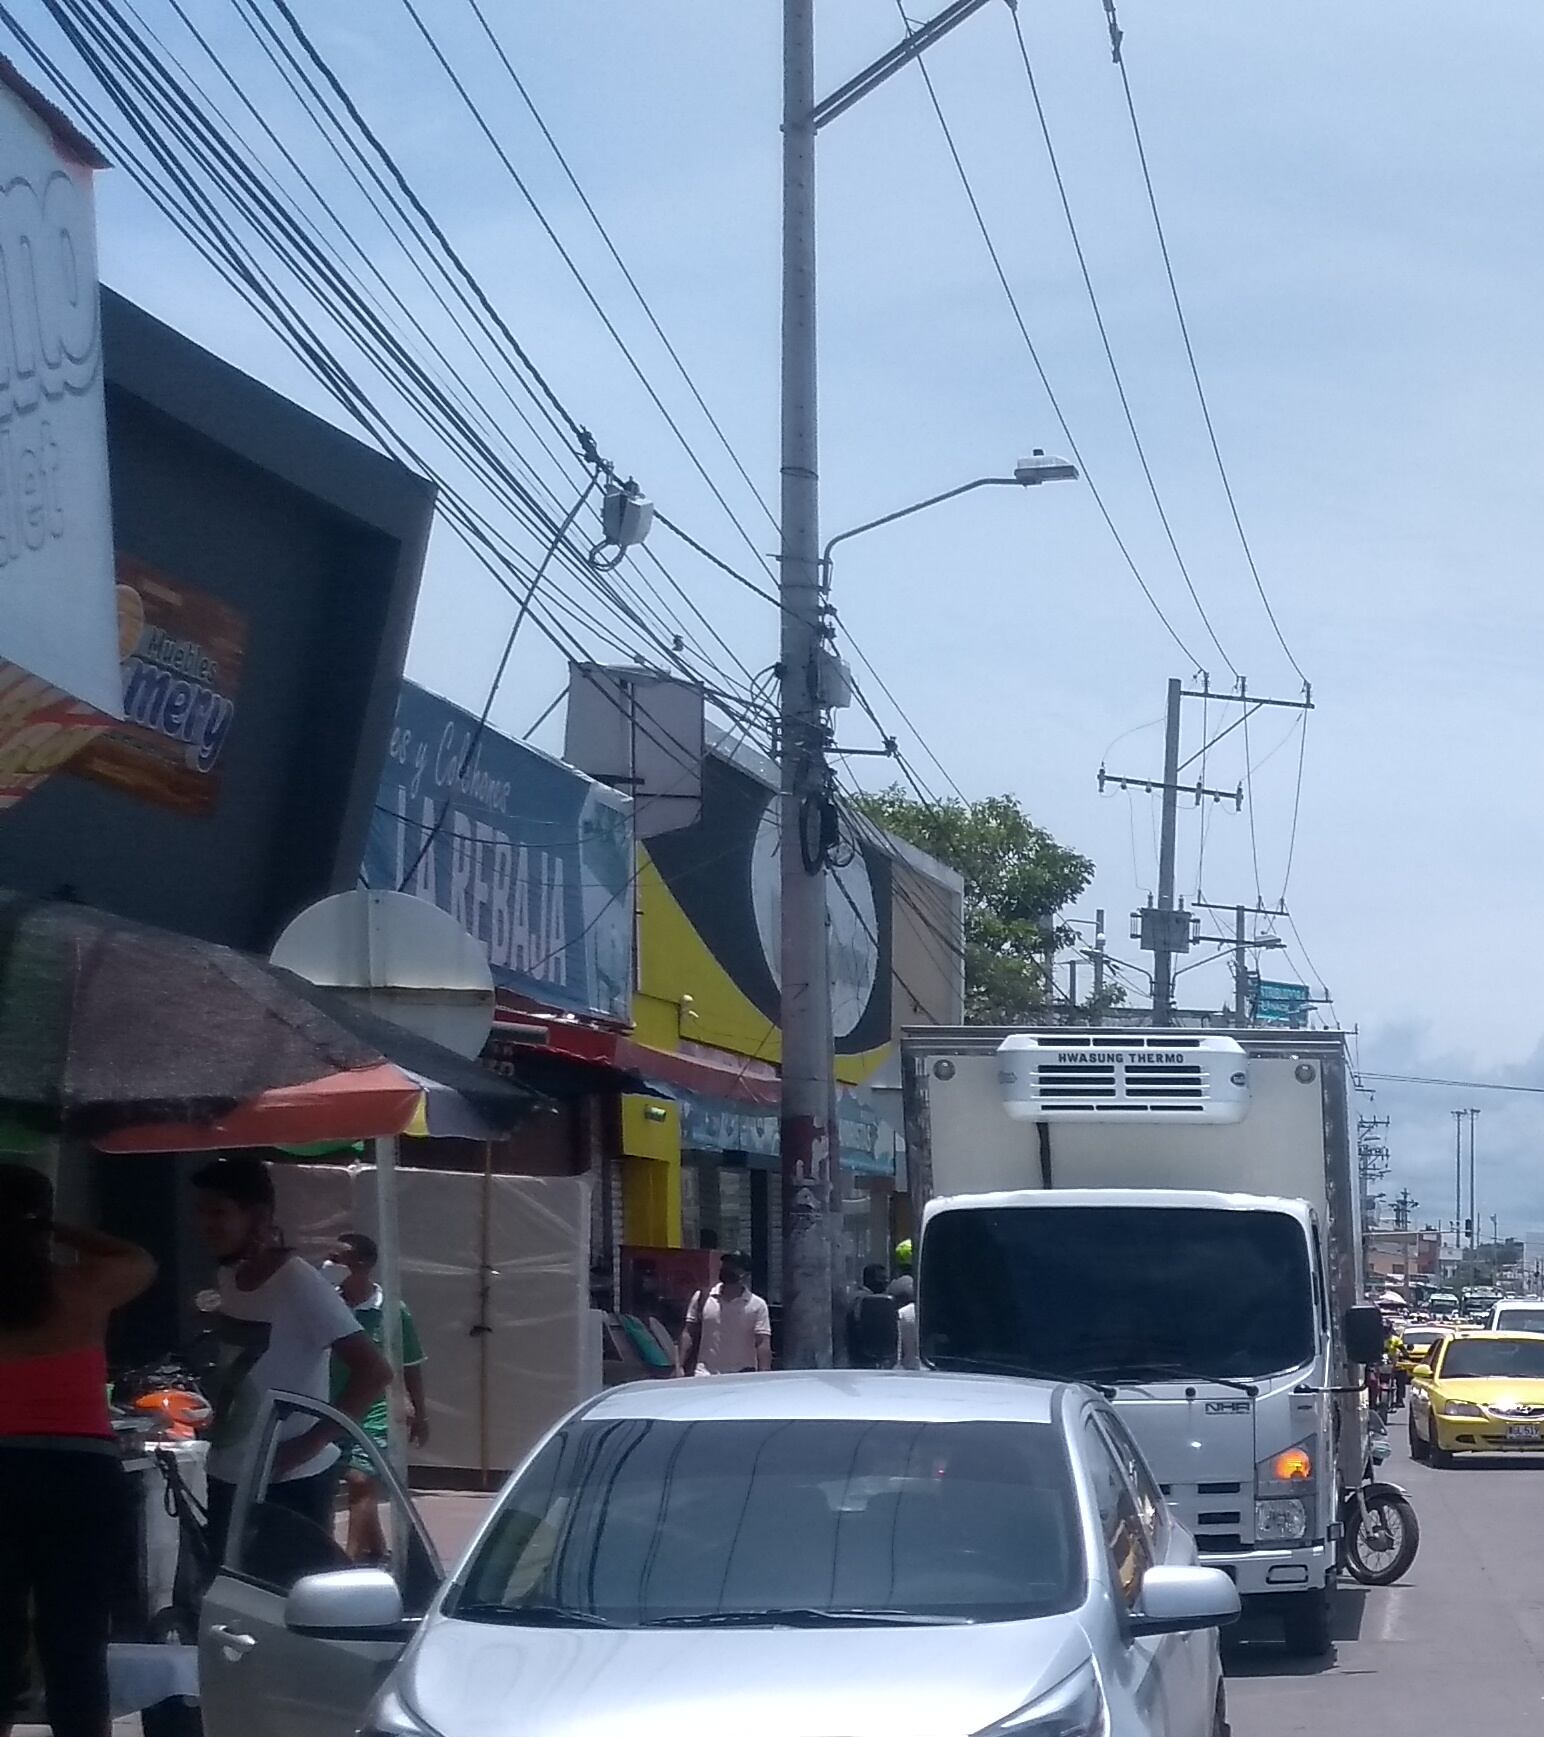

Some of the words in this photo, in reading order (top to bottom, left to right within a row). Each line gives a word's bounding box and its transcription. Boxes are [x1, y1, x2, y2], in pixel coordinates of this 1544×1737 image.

[411, 742, 428, 800] y
[451, 811, 567, 987] REBAJA
[1058, 1053, 1124, 1064] HWASUNG
[1128, 1053, 1184, 1064] THERMO
